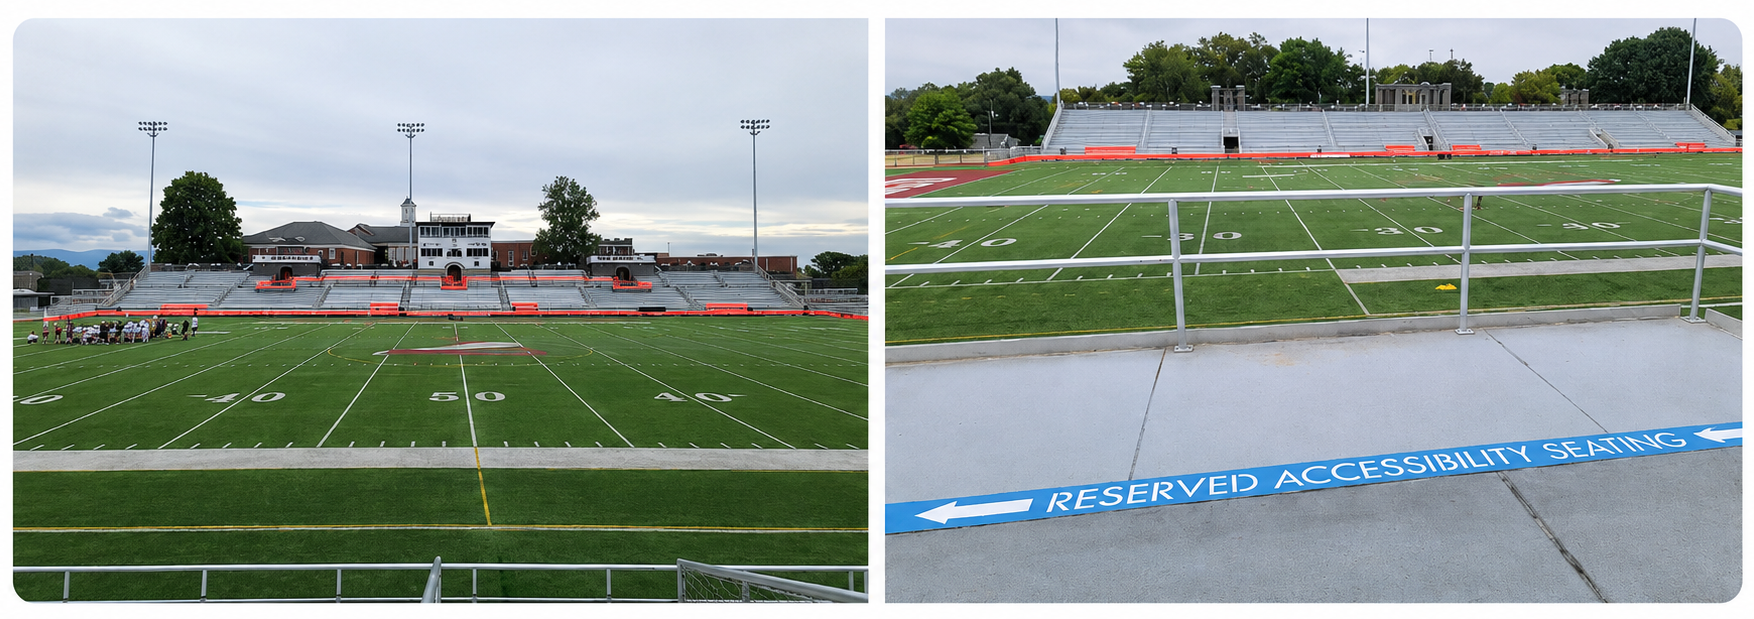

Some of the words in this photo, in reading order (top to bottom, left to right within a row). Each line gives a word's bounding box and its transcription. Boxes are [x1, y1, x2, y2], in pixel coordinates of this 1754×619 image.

[428, 391, 506, 402] 50
[1046, 473, 1259, 513] RESERVED
[1273, 445, 1532, 490] ACCESSIBILITY
[1542, 432, 1687, 460] SEATING
